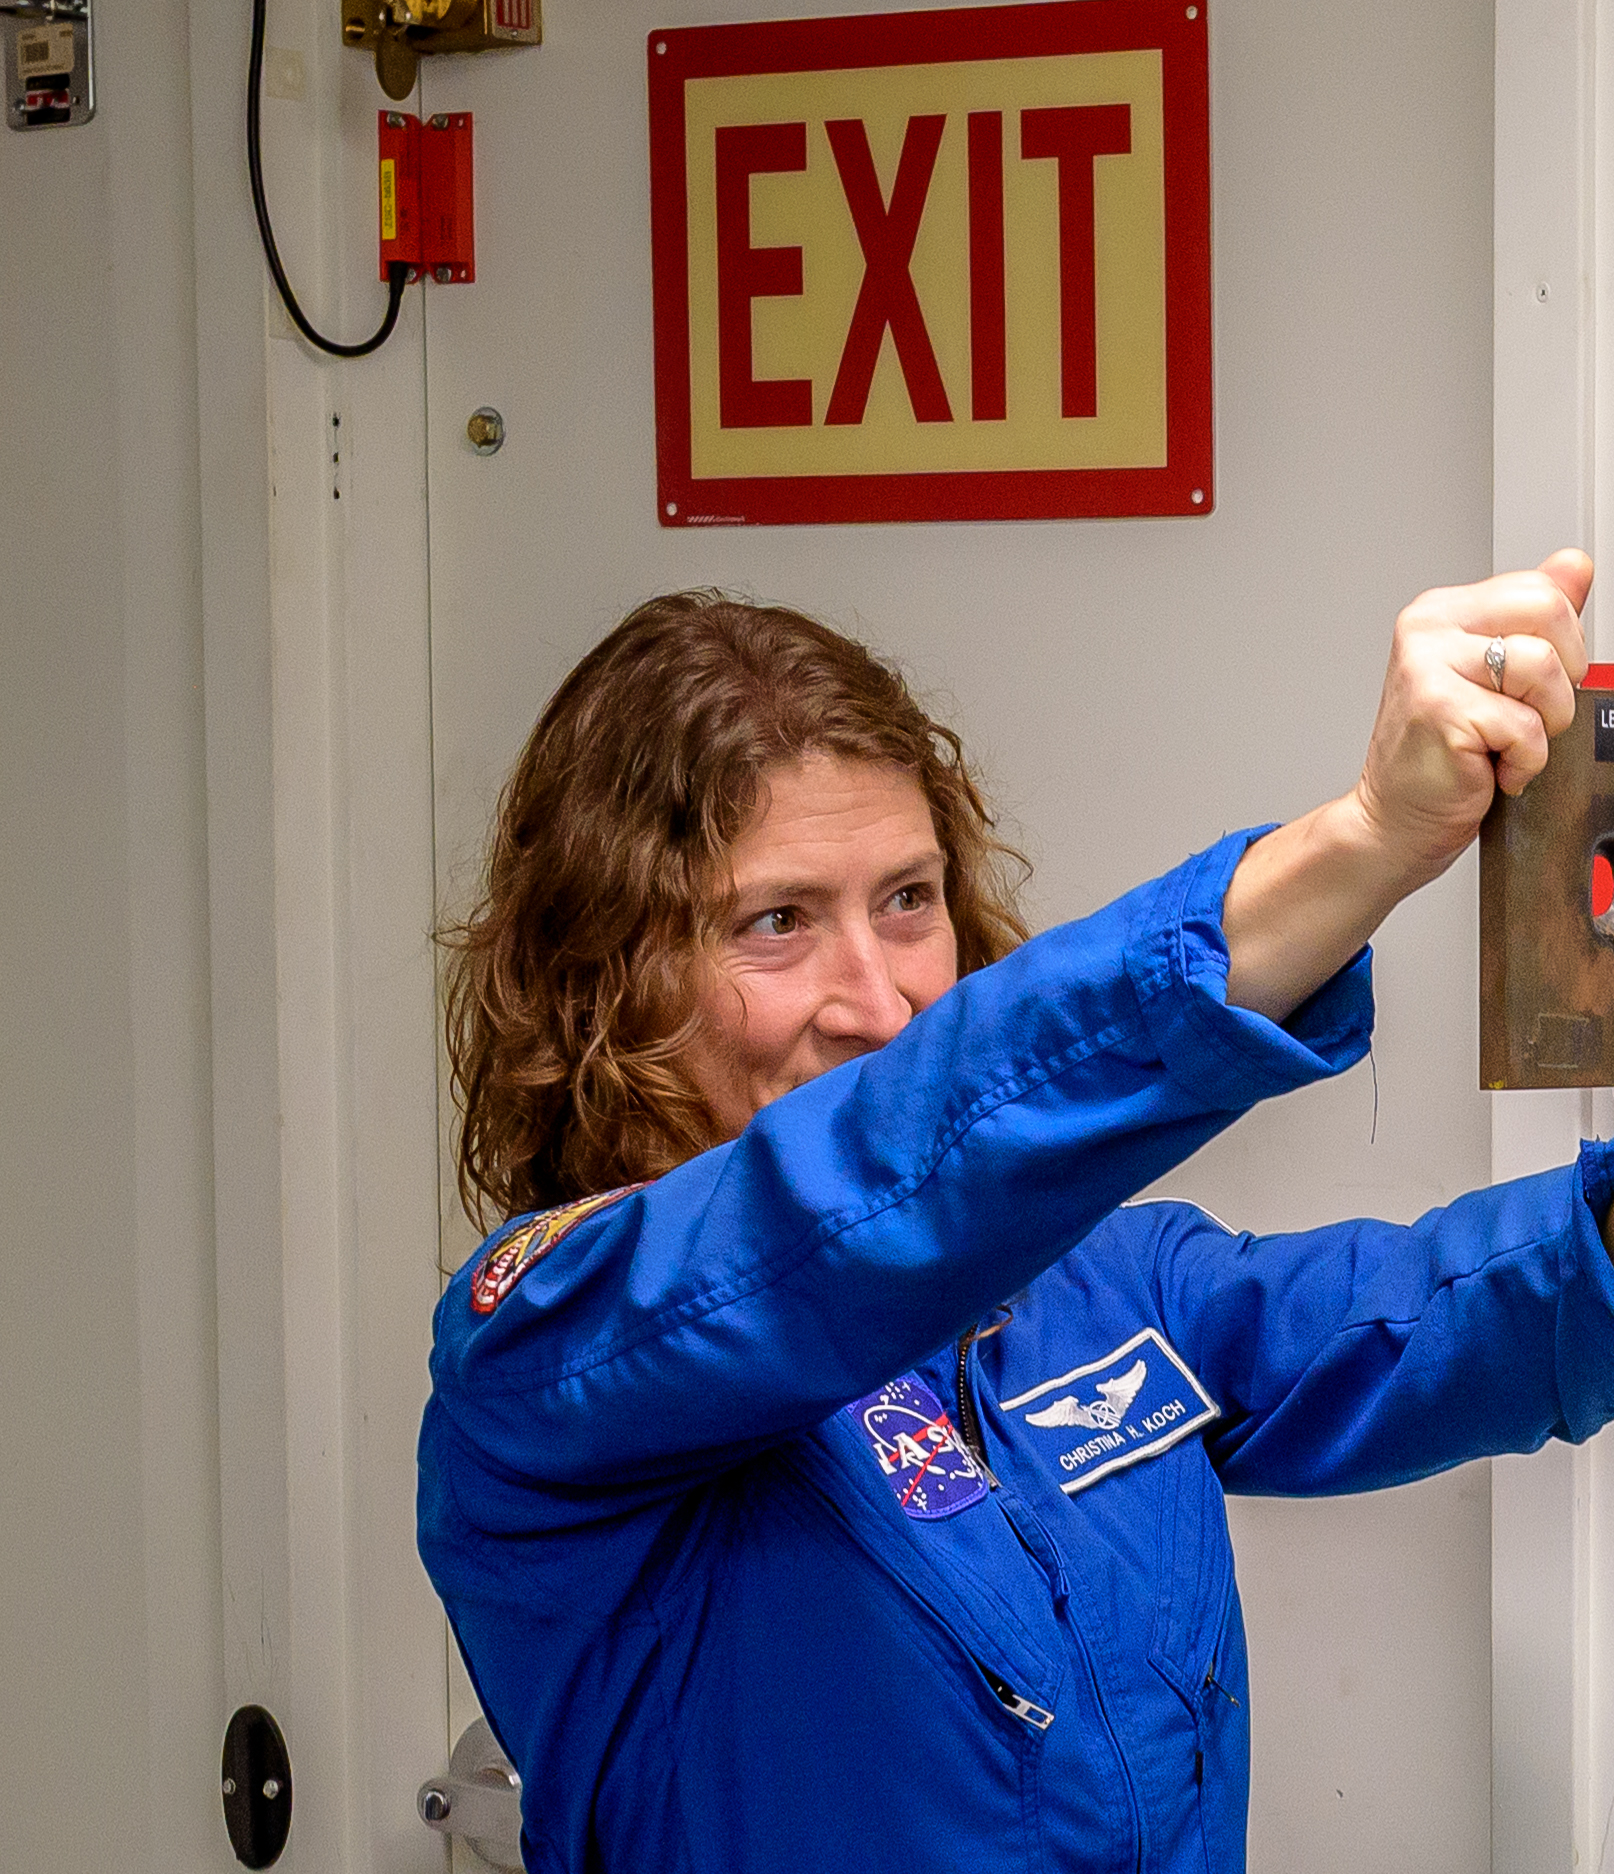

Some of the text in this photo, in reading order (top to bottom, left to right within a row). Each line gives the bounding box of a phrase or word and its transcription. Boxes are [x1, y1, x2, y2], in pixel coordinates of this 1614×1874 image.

[714, 103, 1132, 429] EXIT
[1059, 1431, 1126, 1471] CHRISTINA
[1141, 1399, 1186, 1433] KOCH
